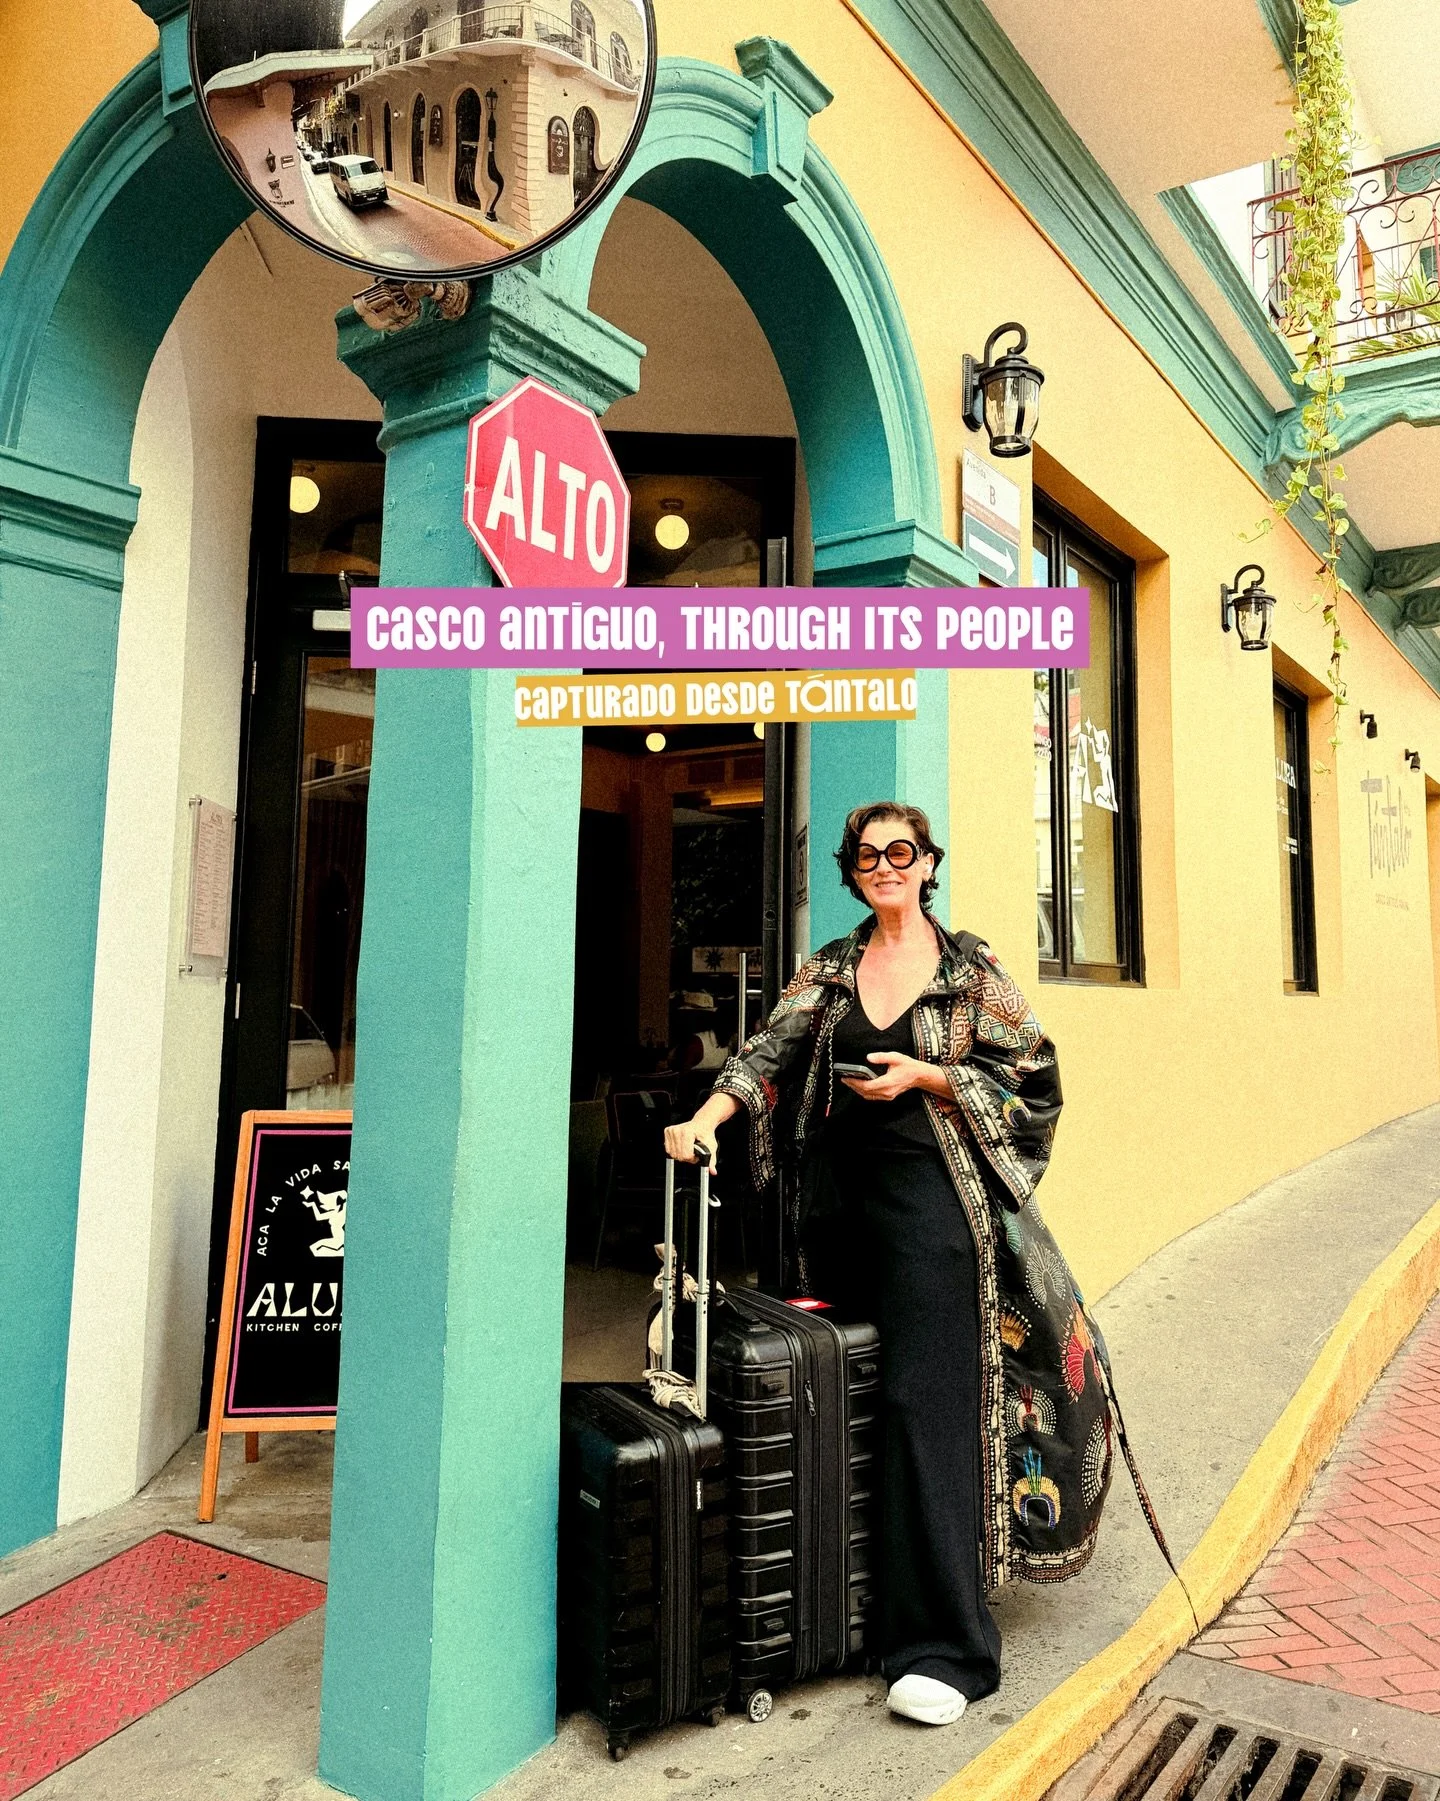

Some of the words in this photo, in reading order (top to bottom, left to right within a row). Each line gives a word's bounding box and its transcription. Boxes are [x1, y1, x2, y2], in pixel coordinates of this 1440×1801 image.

[485, 435, 616, 574] ALTO
[990, 485, 996, 506] B
[257, 1225, 270, 1256] ACA
[265, 1195, 283, 1213] LA
[285, 1163, 321, 1187] VIDA
[246, 1282, 343, 1317] ALU
[246, 1323, 300, 1332] KITCHEN
